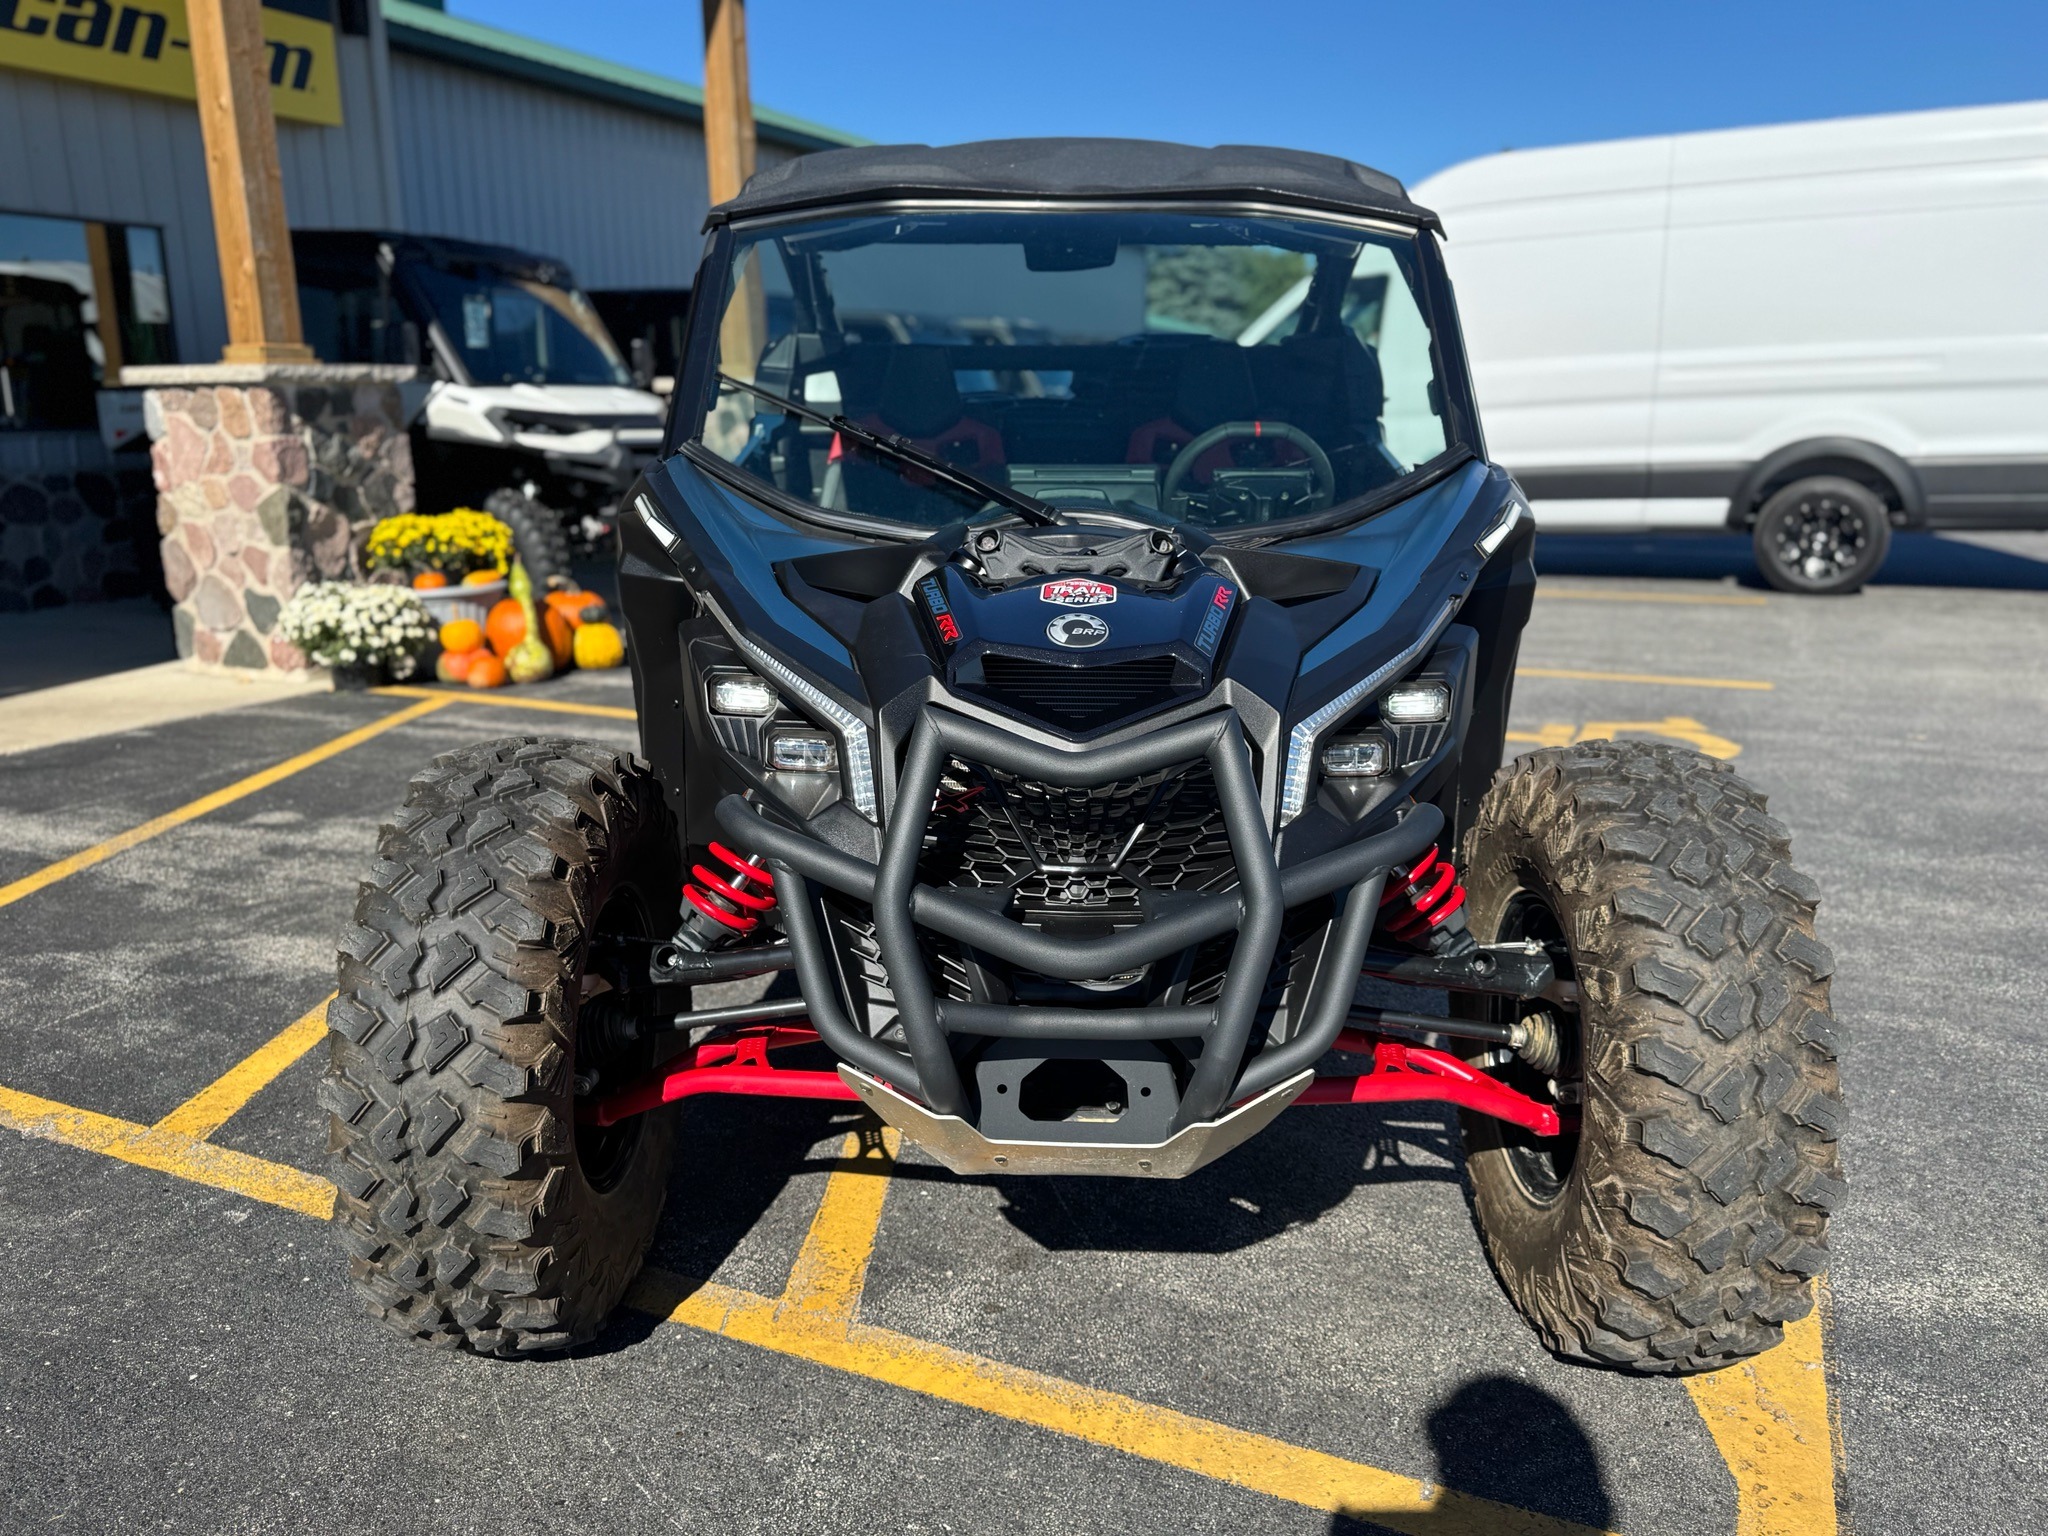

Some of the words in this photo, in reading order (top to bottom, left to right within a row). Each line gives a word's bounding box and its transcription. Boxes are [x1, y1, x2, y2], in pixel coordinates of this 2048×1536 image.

[920, 577, 948, 614] TURBO
[936, 614, 959, 642] RR
[1050, 586, 1106, 594] TRAIL
[1197, 605, 1224, 651] TURBO
[1213, 586, 1233, 610] RR
